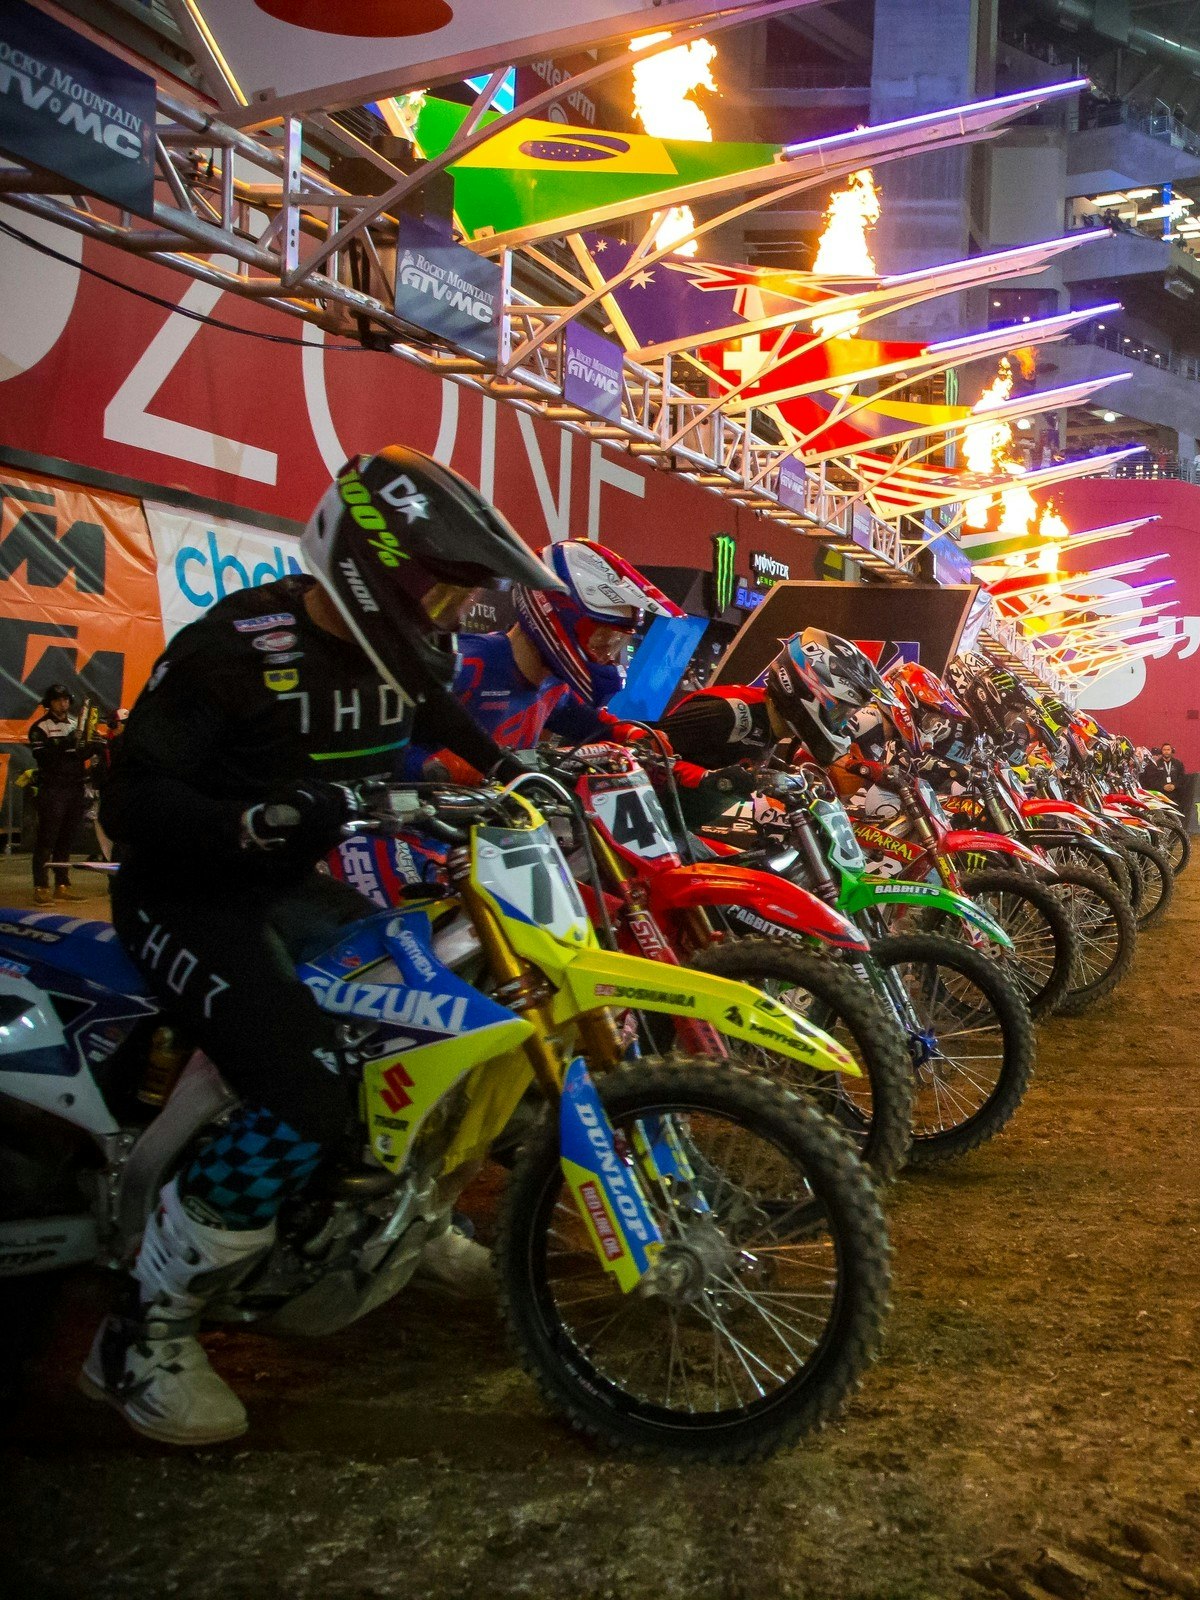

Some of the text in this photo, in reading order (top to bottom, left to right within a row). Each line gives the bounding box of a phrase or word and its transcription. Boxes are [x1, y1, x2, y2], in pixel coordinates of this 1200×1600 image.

[50, 67, 143, 133] MOUNTAIN
[416, 253, 495, 304] ROCKY MOUNTAIN
[753, 553, 789, 580] MONSTER
[853, 824, 914, 861] HAPARRAL
[875, 884, 940, 896] BABBITT'S
[303, 976, 471, 1032] SUZUKI
[574, 1101, 649, 1242] DUNLOP
[581, 1186, 603, 1210] RED
[591, 1210, 612, 1236] LINE
